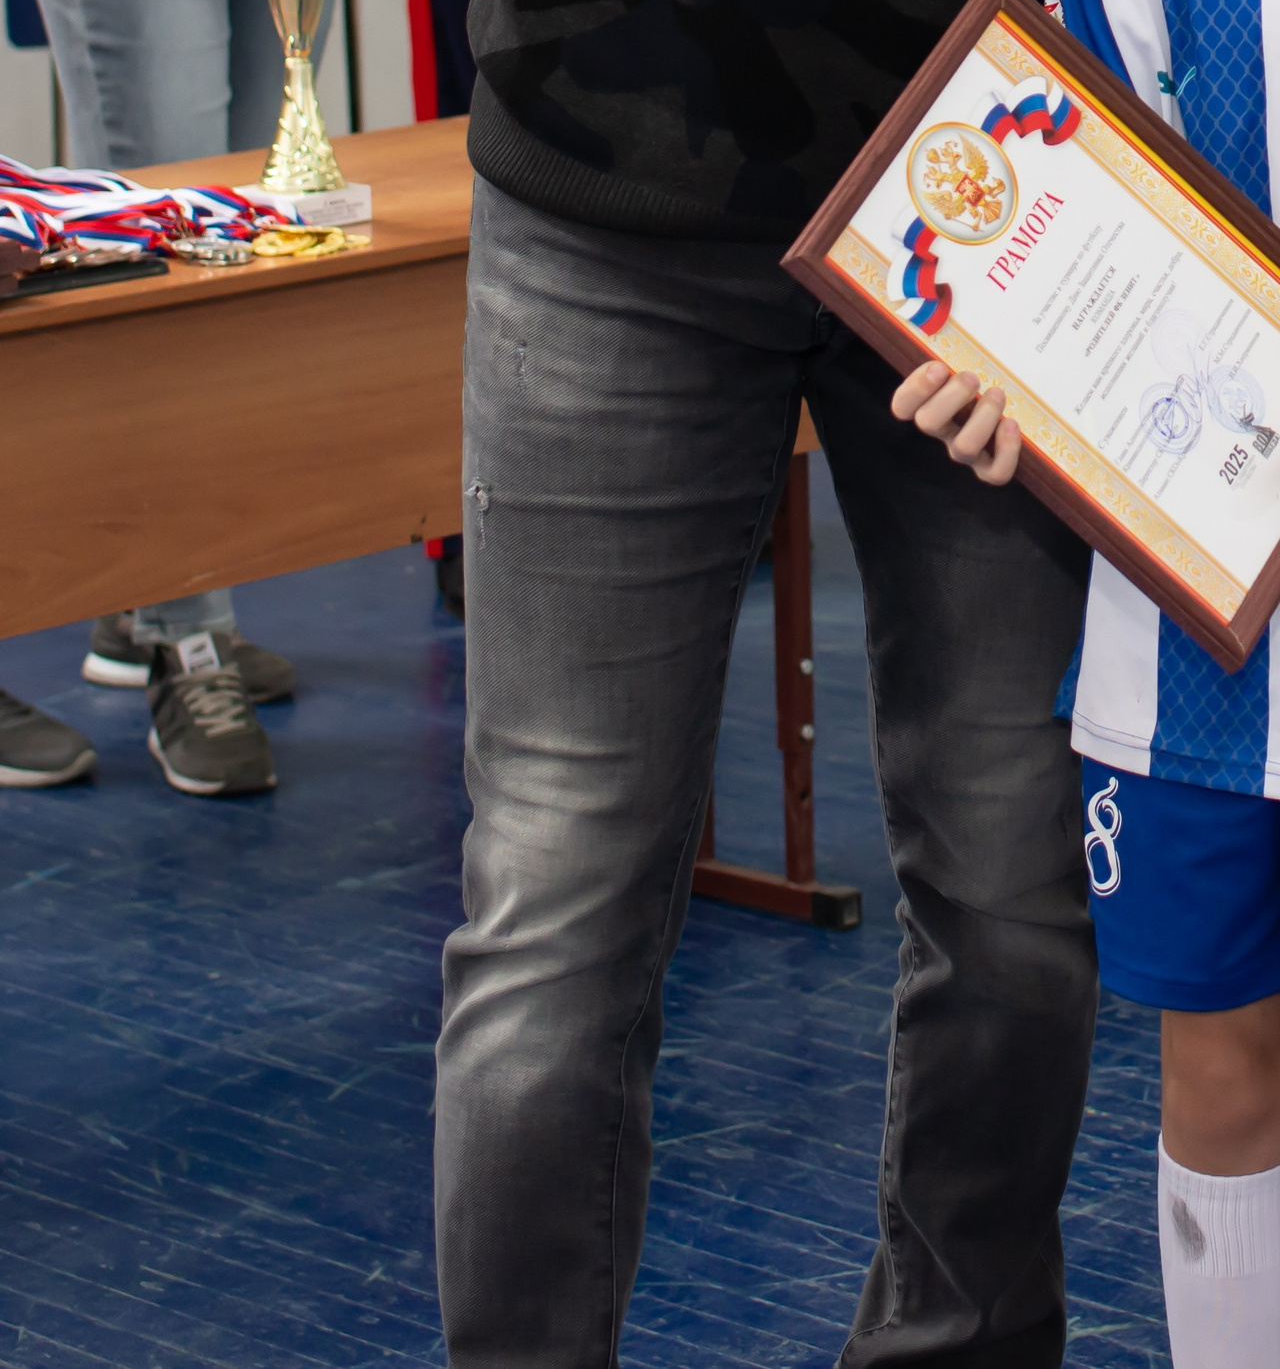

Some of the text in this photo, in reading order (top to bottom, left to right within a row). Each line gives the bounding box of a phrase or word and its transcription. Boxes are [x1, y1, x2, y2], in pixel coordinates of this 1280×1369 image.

[986, 192, 1064, 292] ГРАМОТА
[1032, 316, 1042, 325] За
[1059, 260, 1079, 286] турнире
[1076, 251, 1084, 260] по
[1082, 223, 1103, 252] футболу
[1068, 288, 1082, 305] Дню
[1101, 221, 1125, 253] Отечества
[1072, 265, 1116, 330] НАГРАЖДАЕТСЯ
[1090, 290, 1116, 324] КОМАНДА
[1114, 301, 1123, 311] ФК
[1073, 388, 1095, 415] Желаем
[1100, 345, 1122, 376] крепкого
[1219, 444, 1248, 485] 2025
